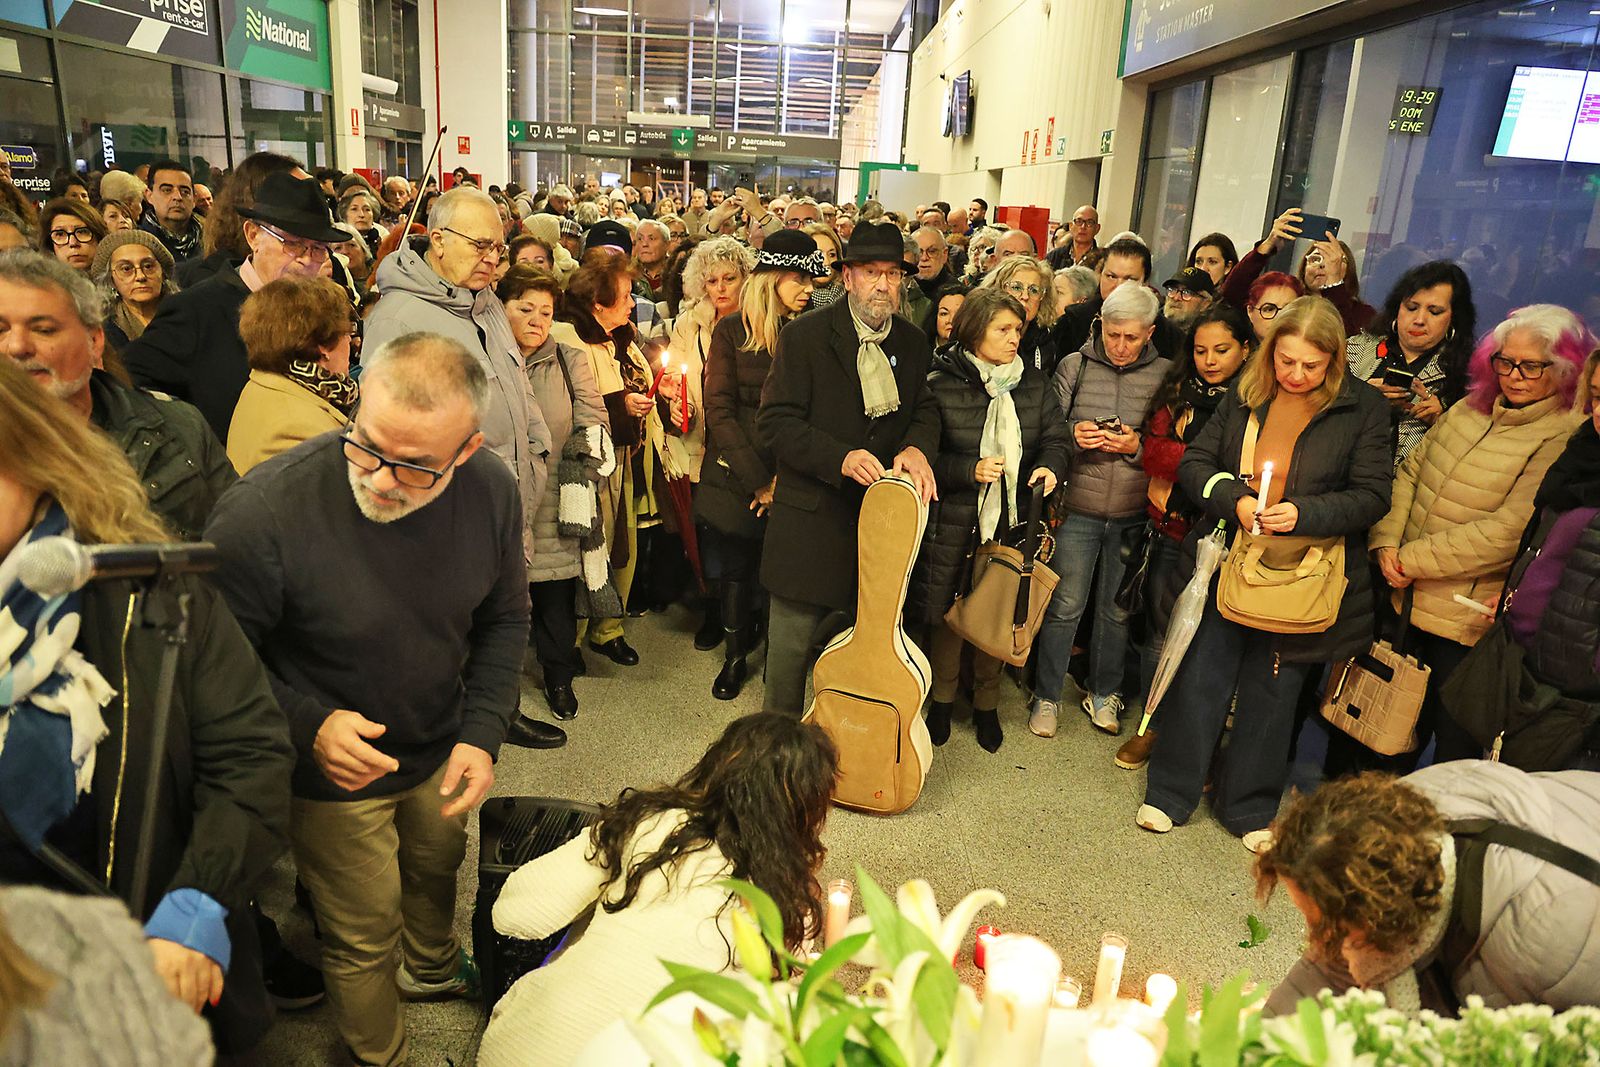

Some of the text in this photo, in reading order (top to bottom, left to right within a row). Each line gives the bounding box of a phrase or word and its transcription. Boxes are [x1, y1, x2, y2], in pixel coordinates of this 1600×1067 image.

[162, 11, 205, 29] rent-a-car
[1183, 4, 1214, 32] MASTER
[261, 15, 311, 52] National
[1400, 90, 1435, 104] 19:29
[1400, 107, 1423, 118] DOM
[556, 126, 577, 134] Salida
[1400, 121, 1424, 132] ENE
[697, 134, 717, 142] Salida
[727, 136, 786, 150] P Aparcamiento
[5, 151, 33, 163] Alamo
